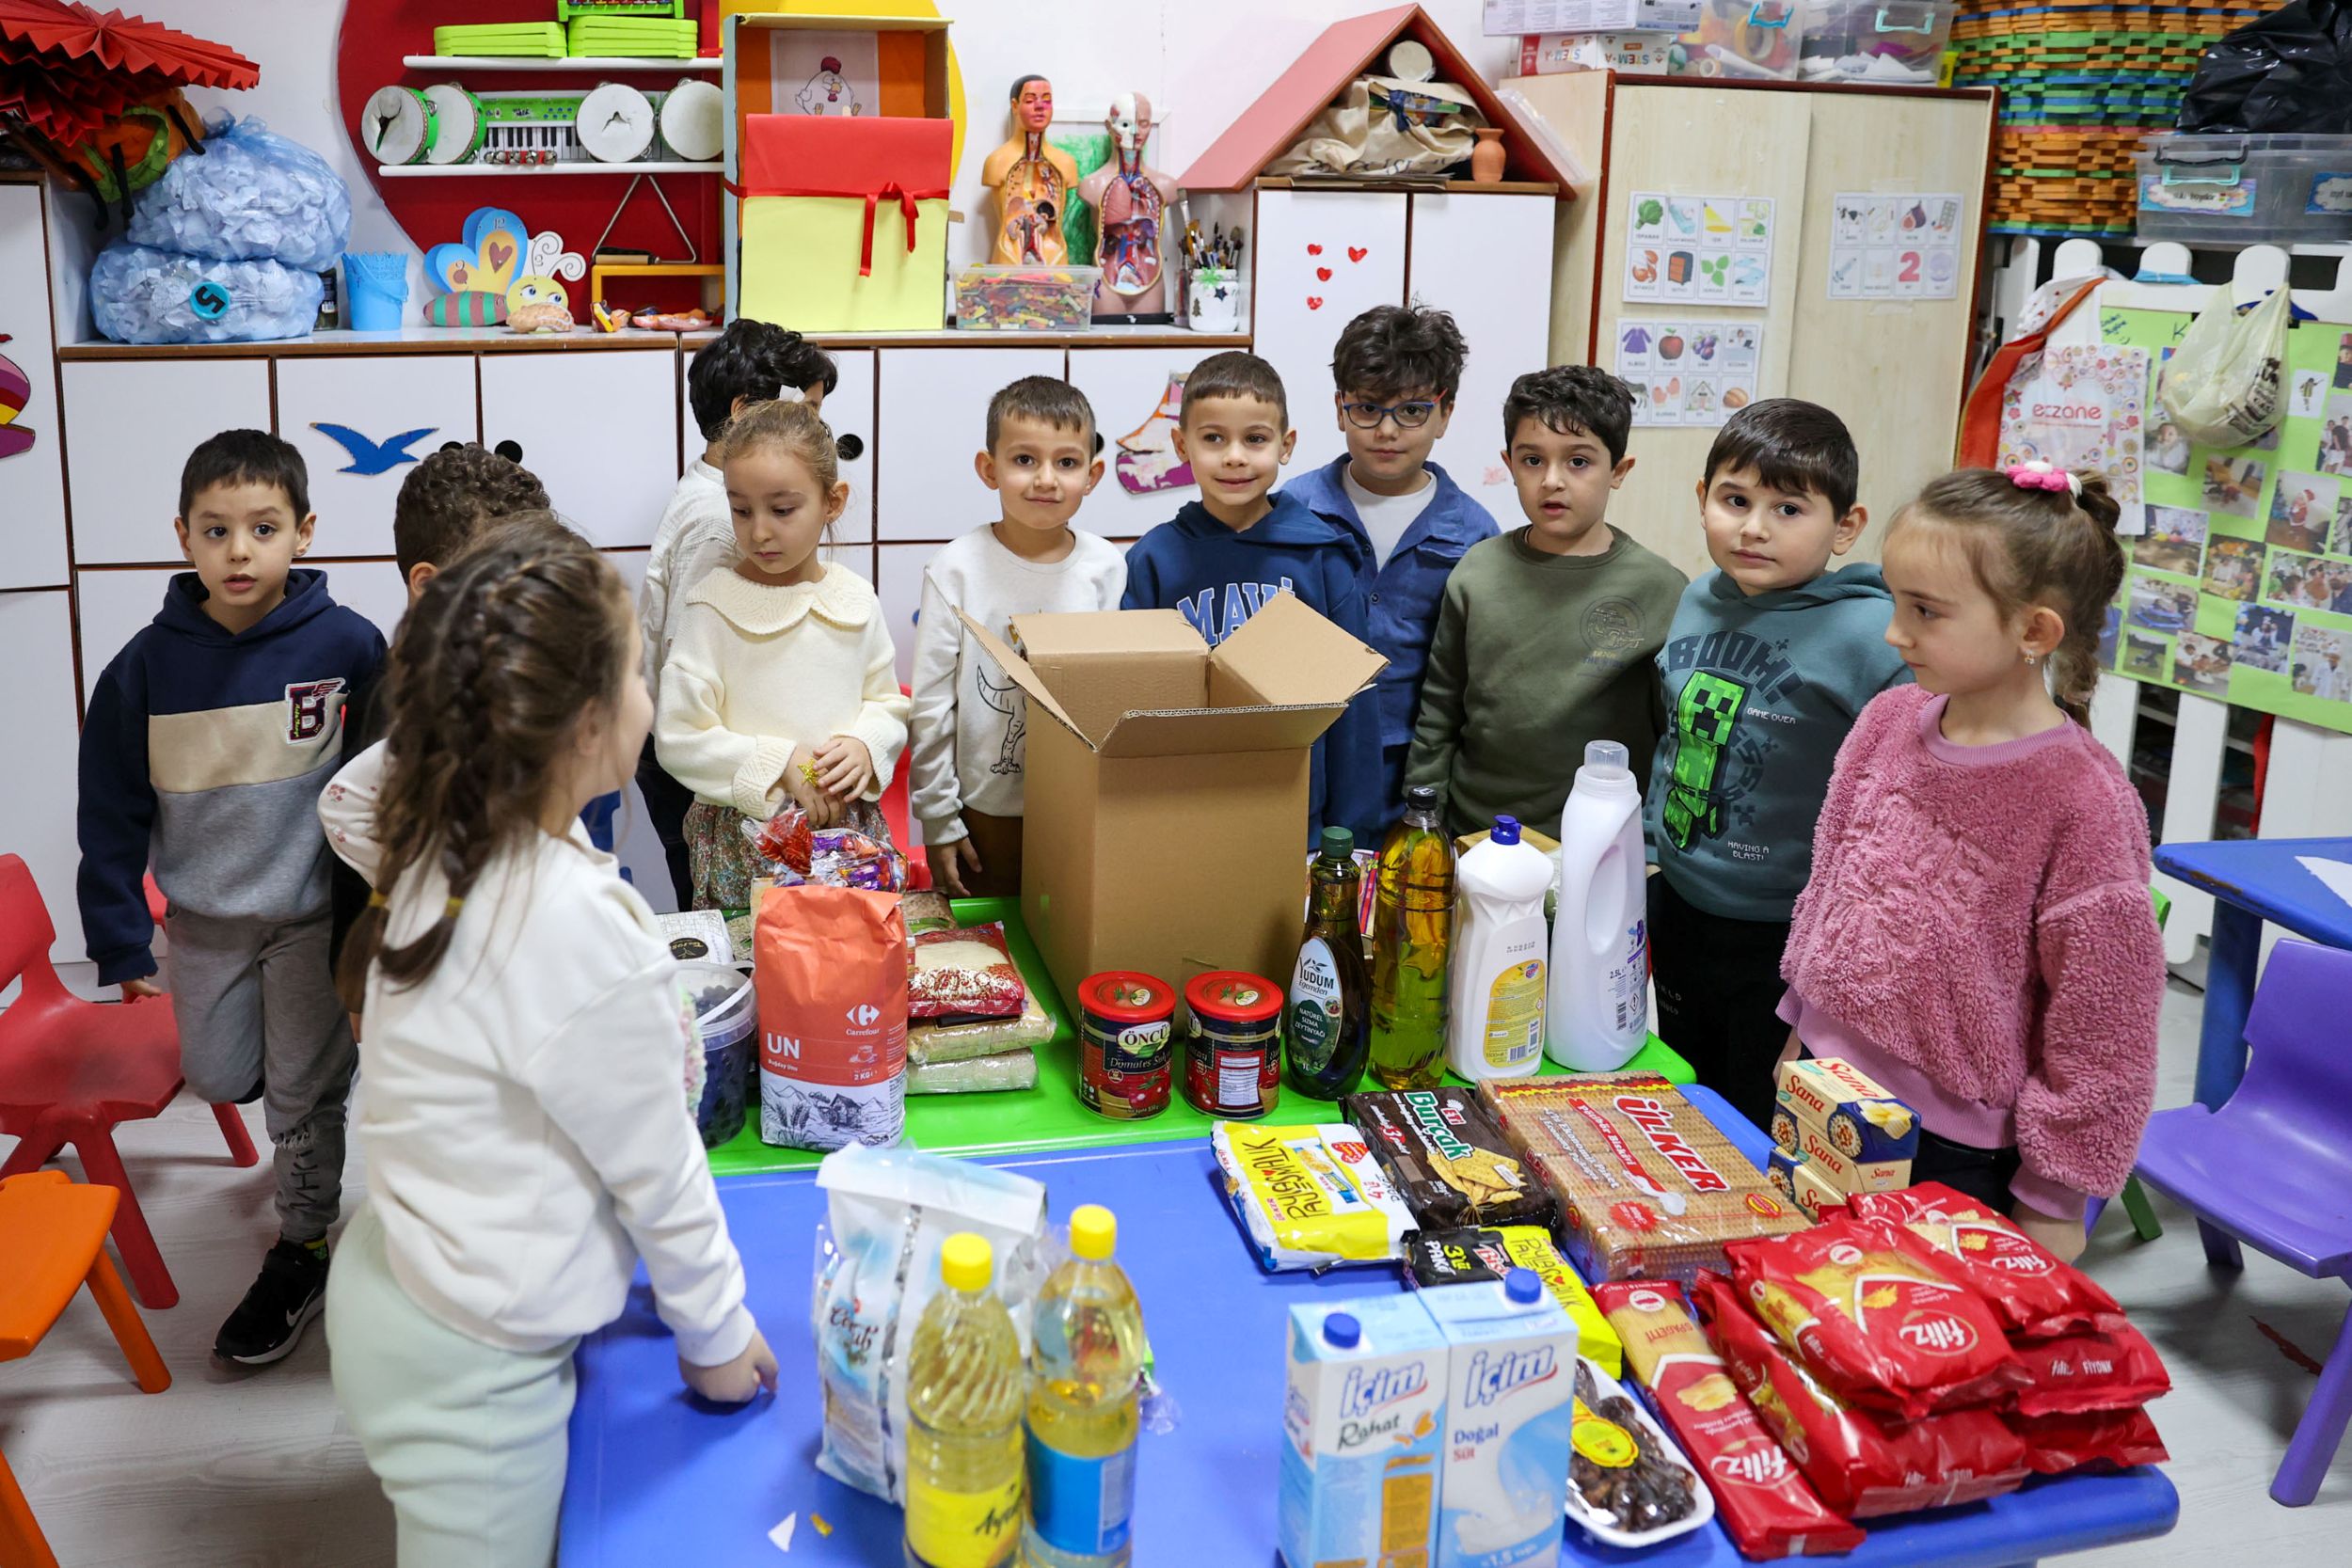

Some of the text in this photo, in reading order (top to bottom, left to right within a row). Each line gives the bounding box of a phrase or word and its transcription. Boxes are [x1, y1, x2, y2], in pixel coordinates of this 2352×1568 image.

[1898, 251, 1921, 282] 2
[1176, 576, 1295, 647] MAV
[1667, 630, 1806, 706] BOOM!
[1746, 706, 1797, 725] GAME OVER
[1727, 840, 1770, 854] HAVING A
[1732, 849, 1765, 862] BLAST!
[1299, 1006, 1324, 1022] NATÜREL
[1301, 1016, 1319, 1028] SIZMA
[846, 1028, 881, 1037] Carrefour
[1124, 1023, 1171, 1046] ÖNCÜ
[1295, 1021, 1326, 1038] ZEYTİNYAĞI
[767, 1032, 800, 1060] UN
[1110, 1056, 1152, 1070] Domates
[1816, 1059, 1881, 1099] Sana
[1786, 1075, 1825, 1113] Sana
[1382, 1127, 1402, 1138] 3
[1404, 1091, 1475, 1162] Burçak
[1556, 1120, 1597, 1164] Ekonomik
[1614, 1096, 1729, 1191] ÜLKER
[1804, 1134, 1844, 1175] Sana
[1871, 1167, 1896, 1180] Sana
[1991, 1254, 2048, 1272] filiz
[1899, 1318, 1965, 1350] filiz
[1337, 1414, 1400, 1452] Rahat
[1454, 1423, 1500, 1444] Doğal
[1454, 1447, 1476, 1462] Süt
[1710, 1445, 1788, 1482] filiz
